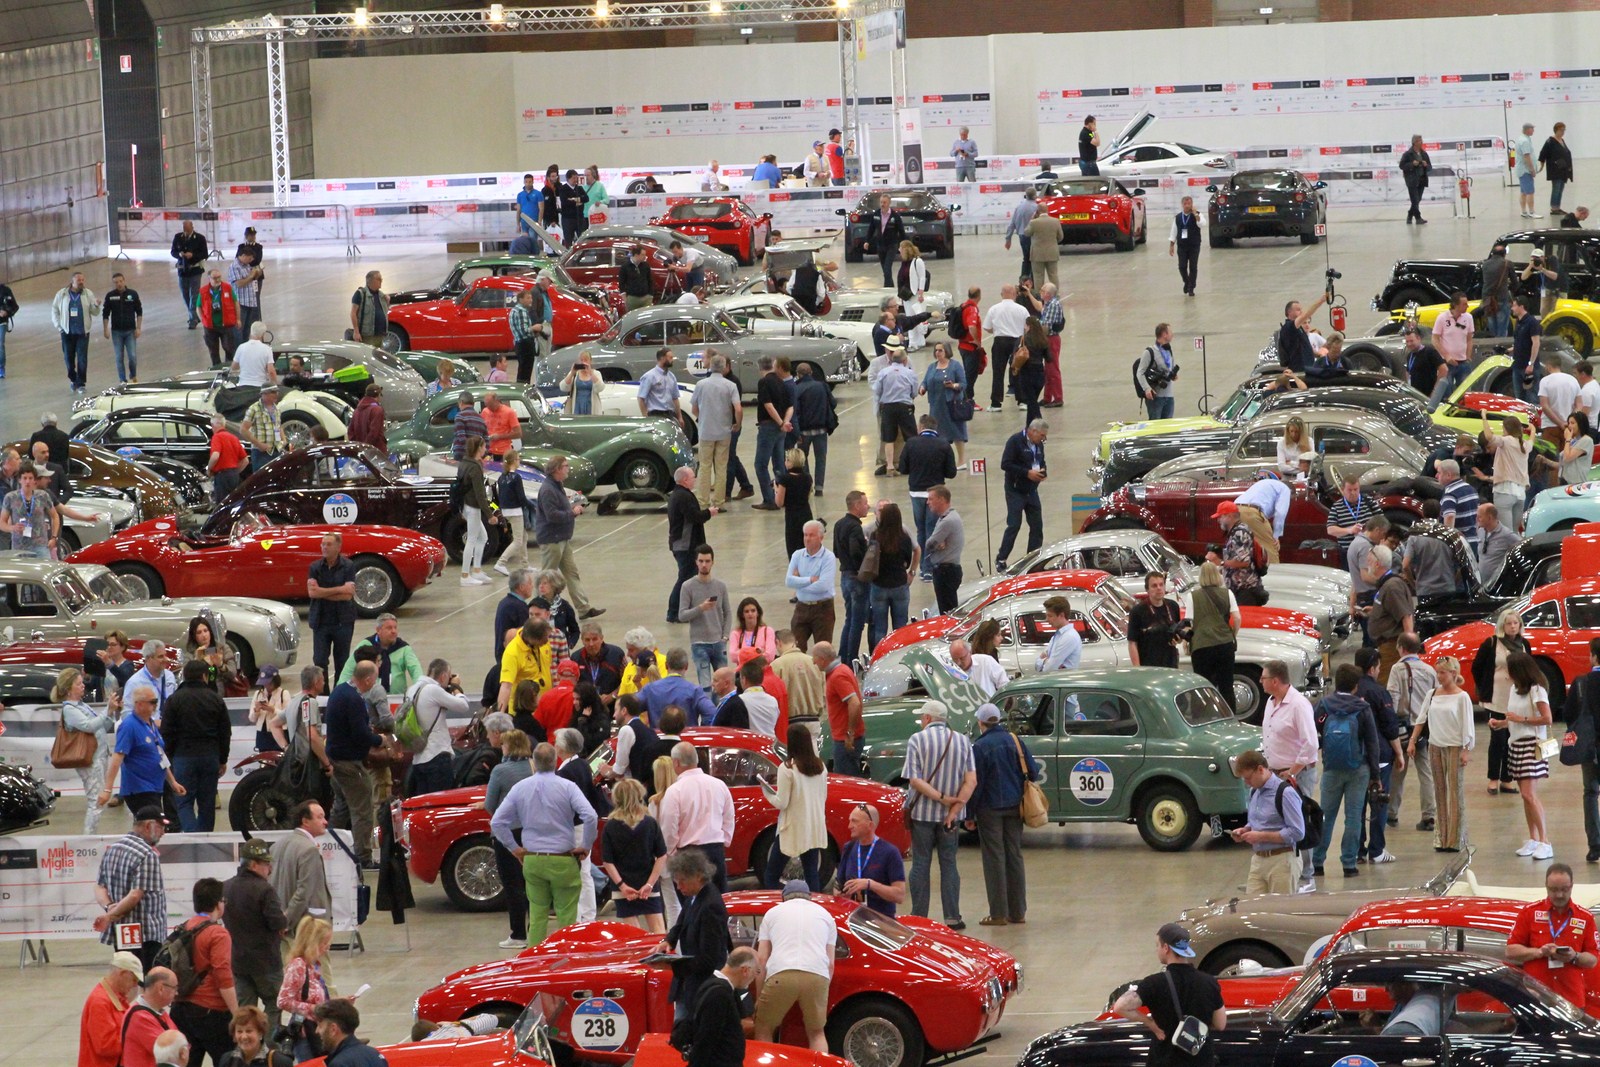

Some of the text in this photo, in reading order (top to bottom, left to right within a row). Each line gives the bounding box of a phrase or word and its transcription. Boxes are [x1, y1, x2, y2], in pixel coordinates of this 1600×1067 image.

[1445, 319, 1452, 327] 3
[331, 506, 349, 518] 103
[1079, 775, 1104, 791] 360
[47, 840, 97, 858] Mille 2016
[41, 857, 74, 879] Miglia
[584, 1018, 616, 1037] 238
